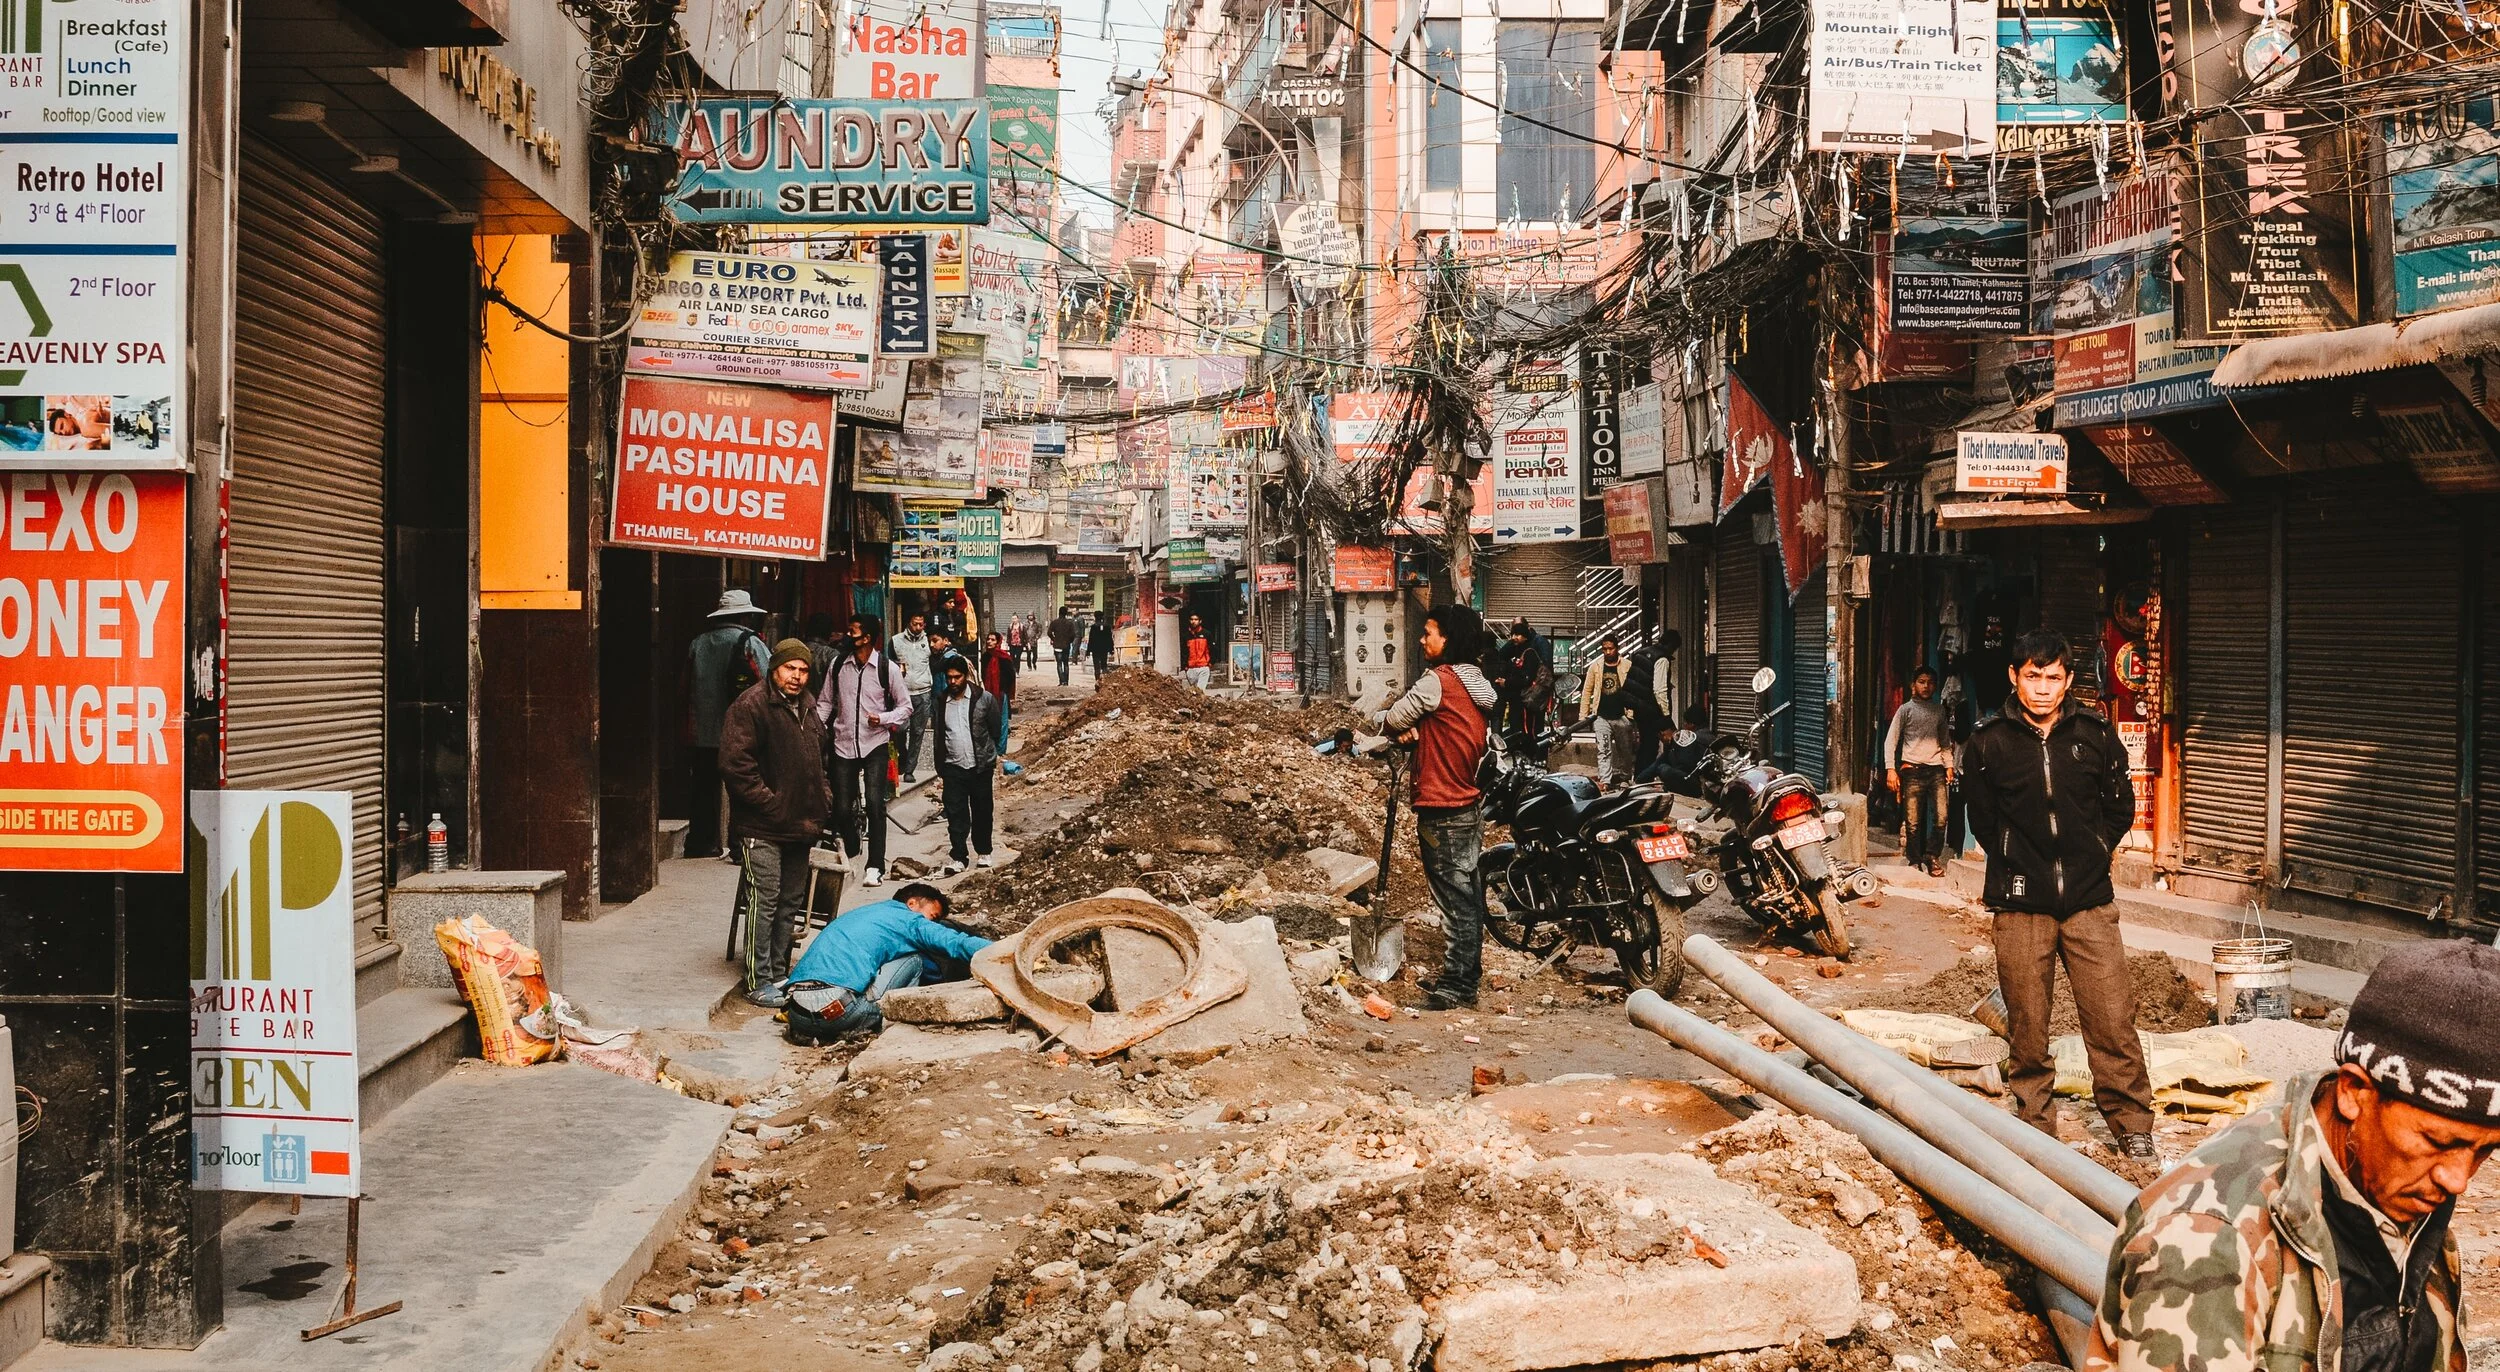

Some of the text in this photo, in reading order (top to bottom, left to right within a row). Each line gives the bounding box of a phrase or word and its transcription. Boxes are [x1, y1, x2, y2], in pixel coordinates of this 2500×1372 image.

[67, 19, 167, 36] Breakfast
[849, 15, 967, 56] Nasha
[1908, 26, 1955, 38] Flight
[115, 40, 168, 54] (Cafe)
[68, 57, 131, 74] Lunch
[1824, 57, 1982, 72] Air/Bus/Train Ticket
[10, 75, 43, 88] BAR
[68, 80, 137, 96] Dinner
[871, 62, 940, 98] Bar
[1281, 79, 1332, 88] GAGAN'S
[1269, 88, 1345, 107] TATTOO
[43, 107, 166, 125] Rooftop/Good view
[1297, 107, 1317, 116] INN
[2245, 109, 2311, 214] TREK
[18, 162, 163, 192] Retro Hotel
[778, 181, 976, 213] SERVICE
[29, 203, 145, 225] 3rd & 4th Floor
[2253, 222, 2303, 234] Nepal
[2239, 234, 2317, 246] Trekking
[2429, 232, 2464, 246] Kailash
[2465, 229, 2487, 241] Tour
[2258, 247, 2299, 257] Tour
[692, 259, 797, 283] EURO
[1971, 257, 2020, 268] BHUTAN
[2256, 259, 2302, 269] Tibet
[1897, 277, 1911, 286] P.O.
[1913, 277, 1929, 286] Box:
[1930, 278, 1951, 288] 5019,
[1982, 279, 2024, 288] Kathmandu
[2230, 271, 2328, 282] Mt. Kailash
[2417, 272, 2457, 290] E-mail:
[70, 277, 156, 297] 2nd Floor
[890, 237, 920, 336] LAUNDRY
[2248, 284, 2311, 294] Bhutan
[709, 284, 867, 309] & EXPORT Pvt. Ltd.
[1897, 289, 2024, 303] Tel: 977-1-4422718, 4417875
[2258, 296, 2303, 307] India
[646, 311, 674, 323] DHL
[678, 300, 701, 310] AIR
[750, 305, 776, 316] SEA
[780, 307, 829, 320] CARGO
[1899, 304, 2021, 317] info@basecampadventure.com
[708, 313, 741, 328] FedEx
[1897, 318, 2021, 331] www.basecampadventure.com
[791, 324, 830, 337] aramex
[2144, 328, 2172, 345] TOUR &
[703, 333, 799, 347] COURIER SERVICE
[2069, 333, 2108, 353] TIBET TOUR
[116, 342, 166, 364] SPA
[659, 350, 674, 359] Tel:
[746, 357, 764, 365] Cell:
[2138, 348, 2215, 374] BHUTAN INDIA TOUR
[716, 364, 782, 376] GROUND FLOOR
[707, 391, 750, 407] NEW
[944, 391, 979, 399] EXPEDITION
[2055, 379, 2202, 420] TIBET BUDGET GROUP JOINING
[629, 408, 823, 450] MONALISA
[903, 428, 936, 437] TICKETING
[1963, 437, 2066, 462] Tibet International Travels
[625, 445, 820, 486] PASHMINA
[991, 452, 1028, 469] HOTEL
[1967, 464, 2031, 473] Tel: 01-4444314
[861, 468, 897, 476] SIGHTSEEING
[940, 473, 971, 481] RAFTING
[1593, 466, 1617, 475] INN
[1985, 477, 2041, 488] 1st Floor
[1496, 488, 1532, 497] THAMEL
[657, 483, 786, 520] HOUSE
[0, 474, 138, 553] EXO
[958, 516, 999, 537] HOTEL
[623, 523, 814, 550] THAMEL, KATHMANDU
[958, 541, 999, 558] PRESIDENT
[1, 685, 169, 765] ANGER
[41, 808, 134, 831] THE GATE
[263, 1018, 314, 1040] BAR
